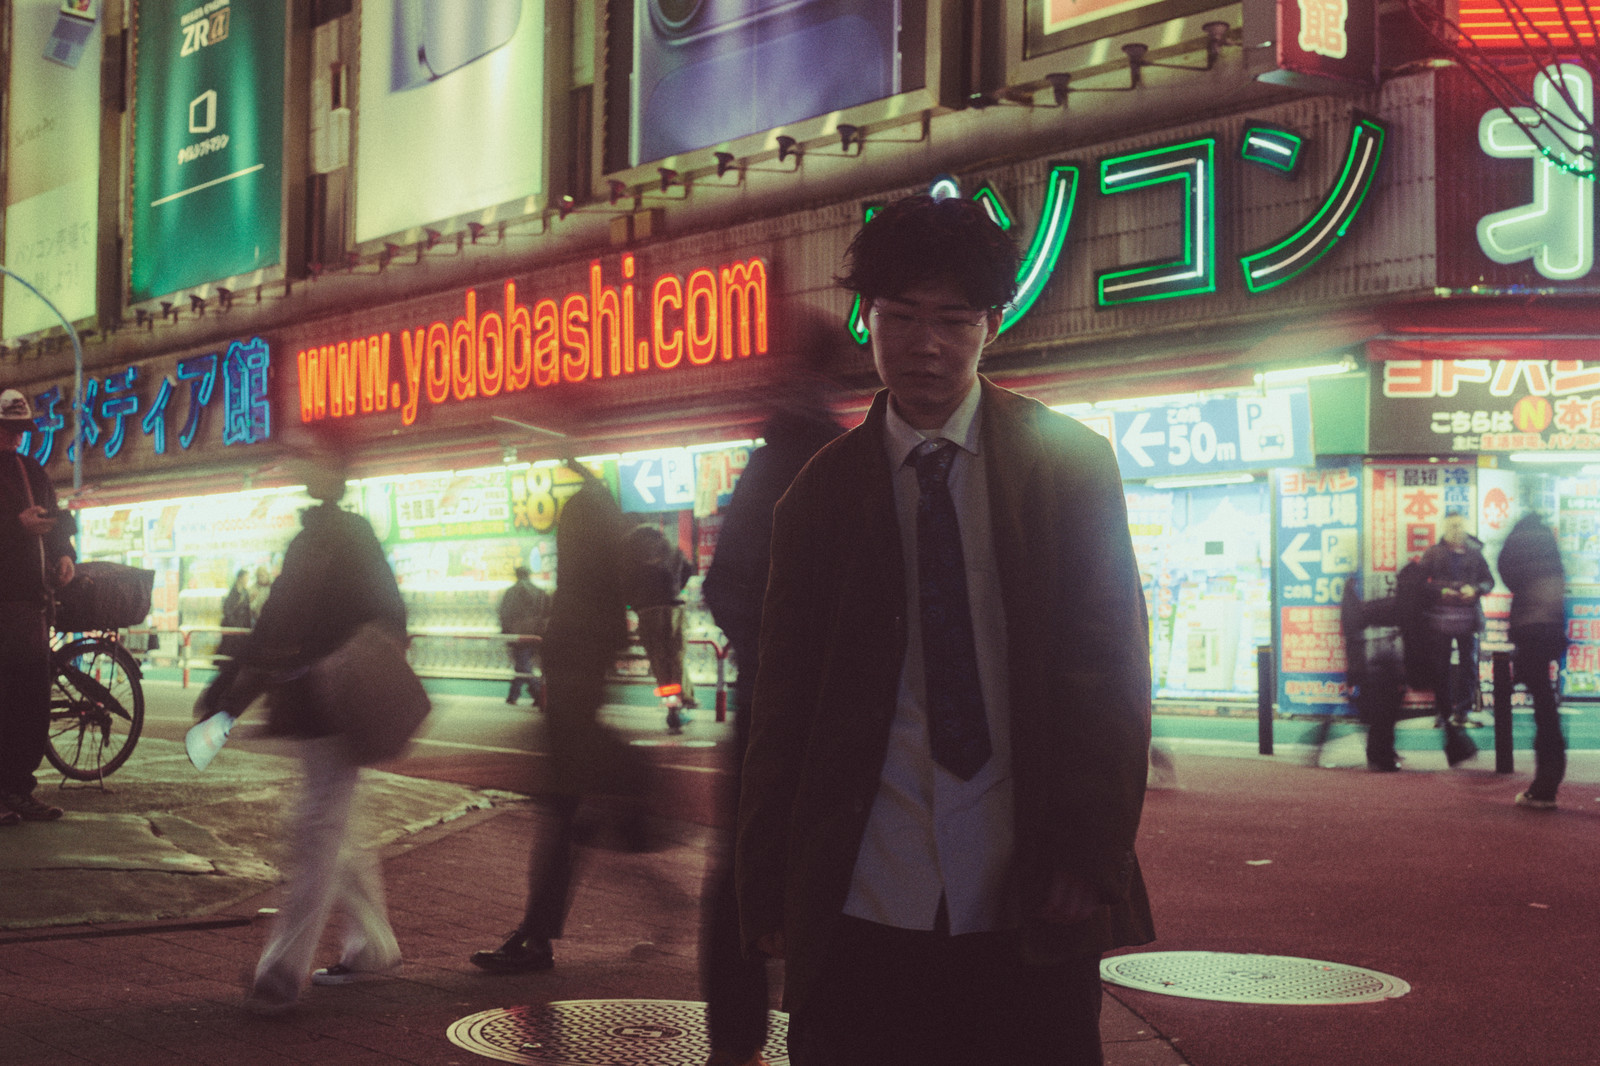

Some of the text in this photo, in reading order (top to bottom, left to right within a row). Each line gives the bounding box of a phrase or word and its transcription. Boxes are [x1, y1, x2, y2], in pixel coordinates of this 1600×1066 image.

[848, 119, 1385, 344] ソコン
[297, 253, 768, 426] www.yodobashi.com
[17, 336, 270, 467] チメディア館
[1431, 395, 1600, 434] こちらはN本
[1168, 421, 1236, 466] 50m
[1281, 468, 1358, 495] ヨドバシ
[1403, 489, 1439, 563] 本日
[1567, 643, 1600, 673] 新
